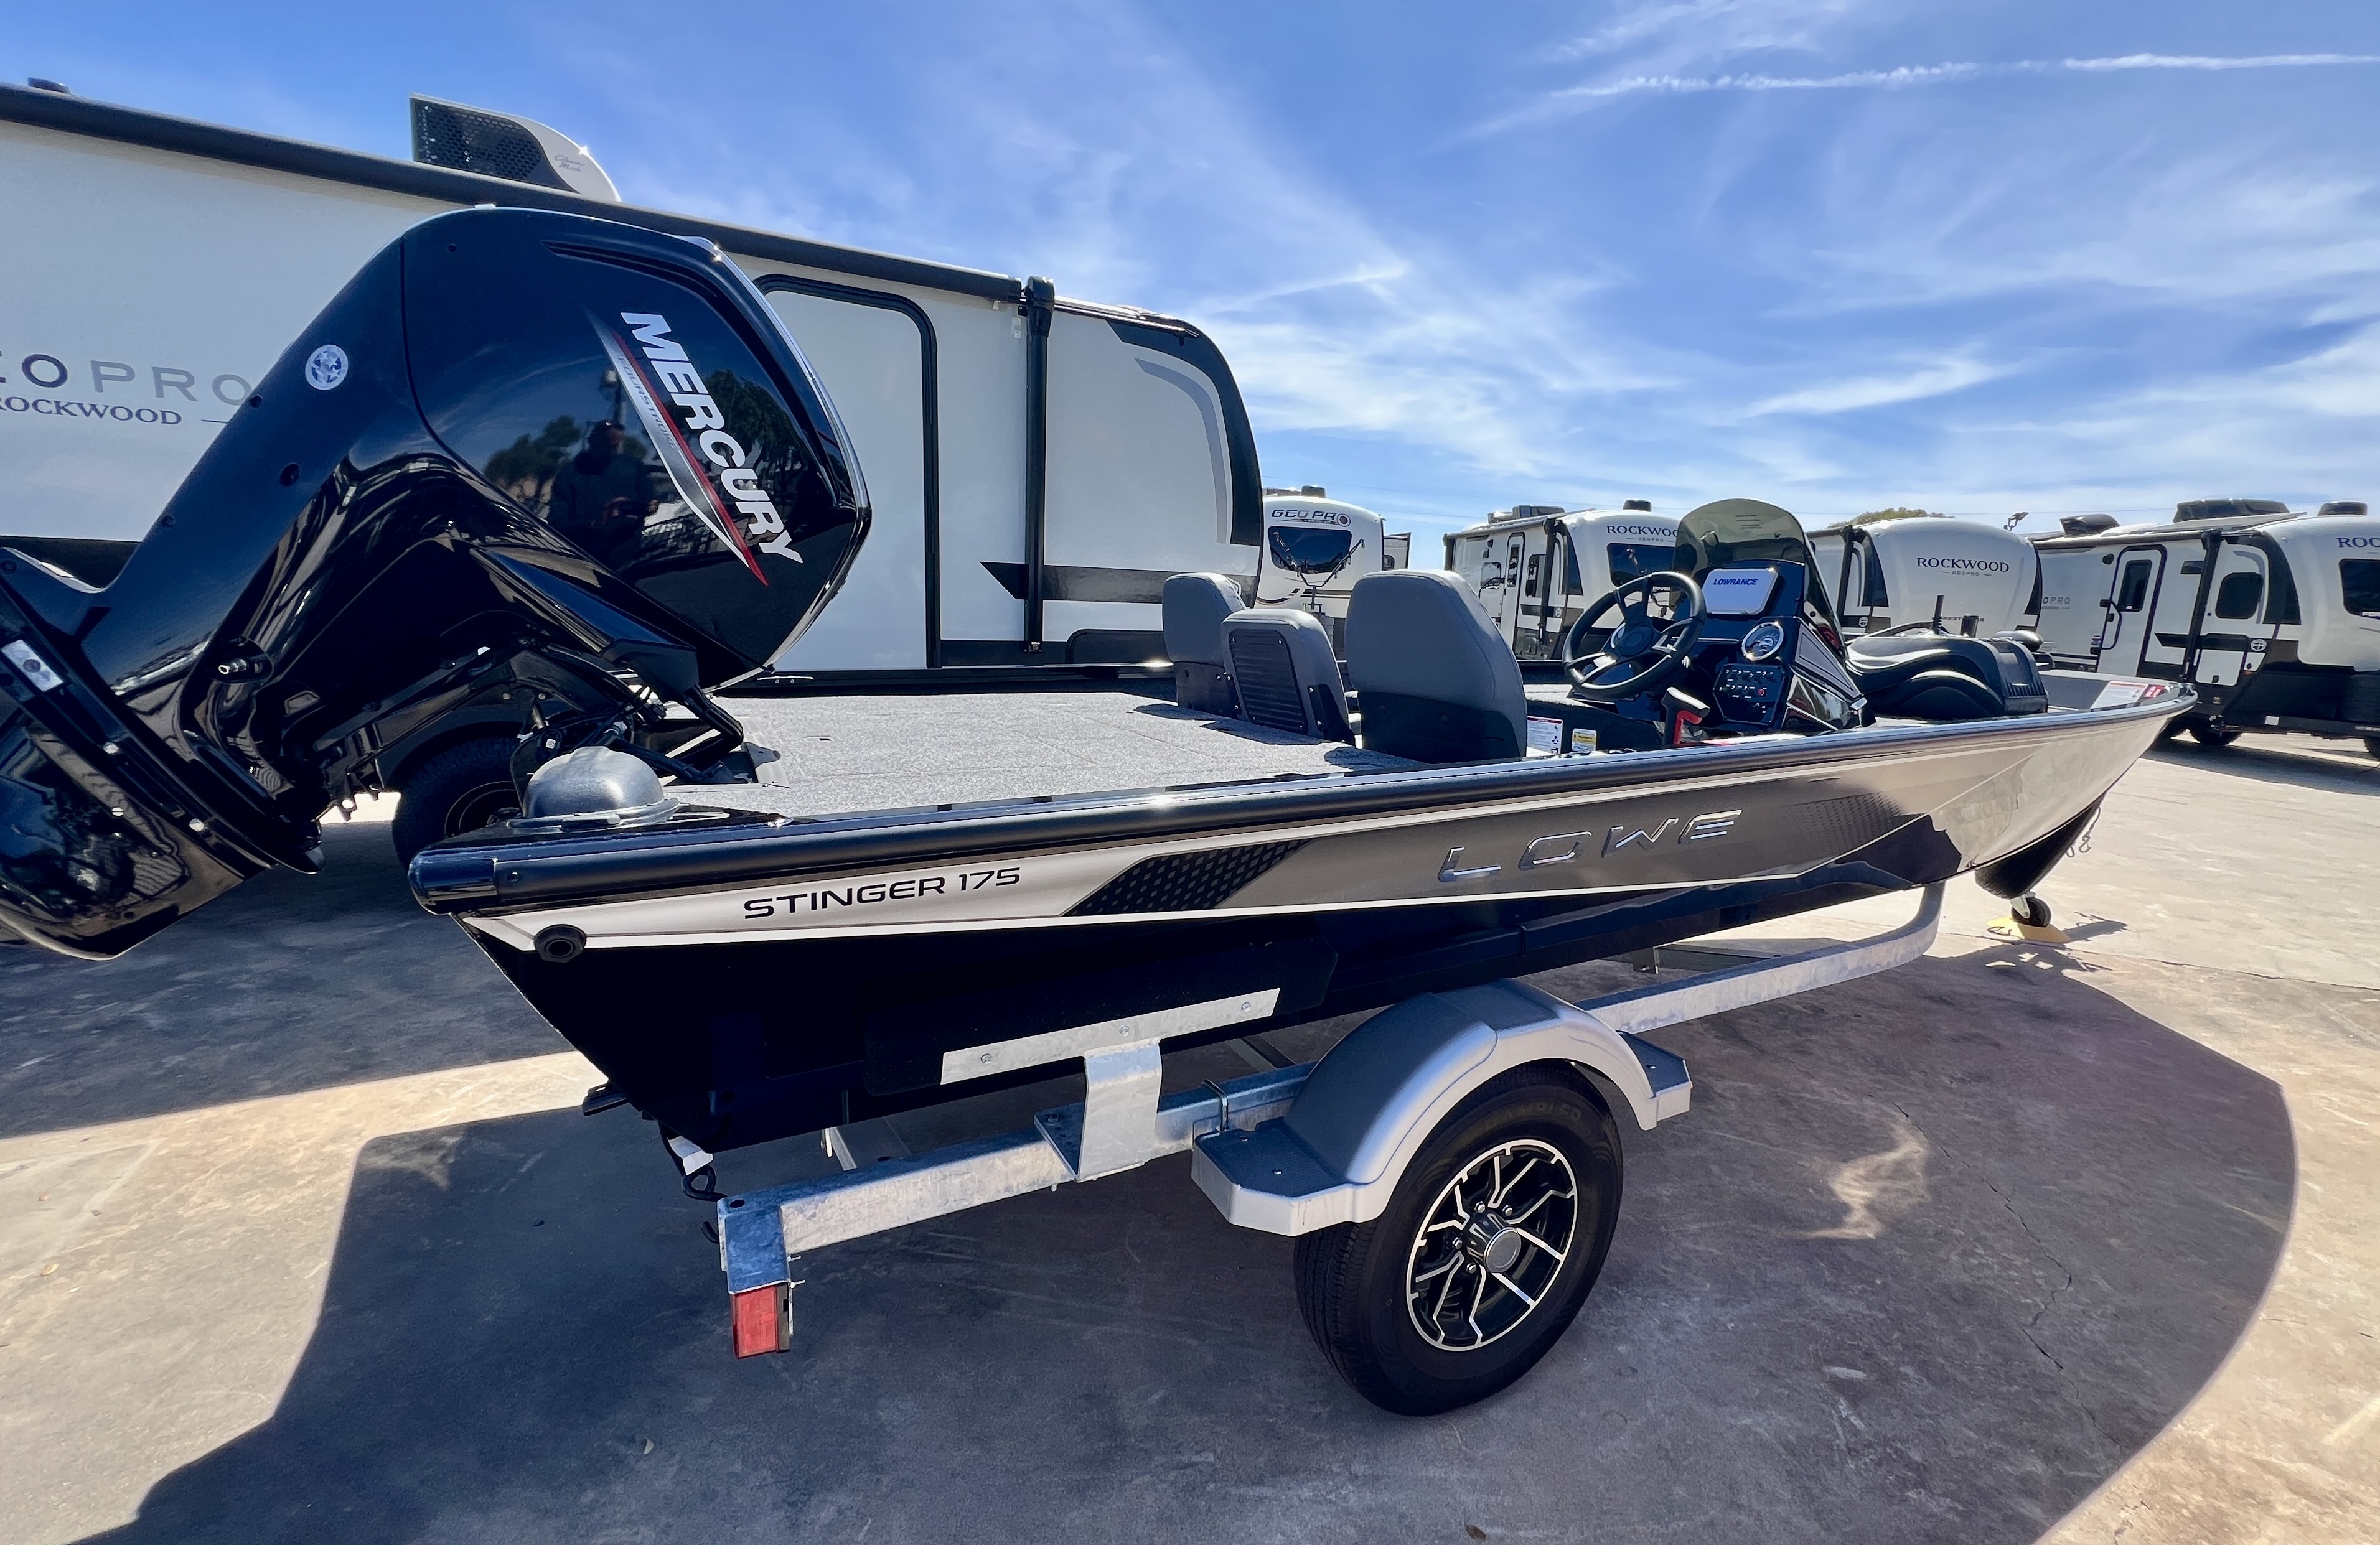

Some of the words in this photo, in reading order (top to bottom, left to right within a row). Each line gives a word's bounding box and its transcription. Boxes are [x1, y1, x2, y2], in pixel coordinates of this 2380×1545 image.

[617, 355, 678, 450] FOURSTROKE
[620, 312, 803, 564] MERCURY
[1272, 510, 1309, 518] GEO
[1916, 558, 2009, 572] ROCKWOOD
[1438, 810, 1743, 882] LOWE
[744, 877, 946, 919] STINGER
[959, 867, 1021, 892] 175
